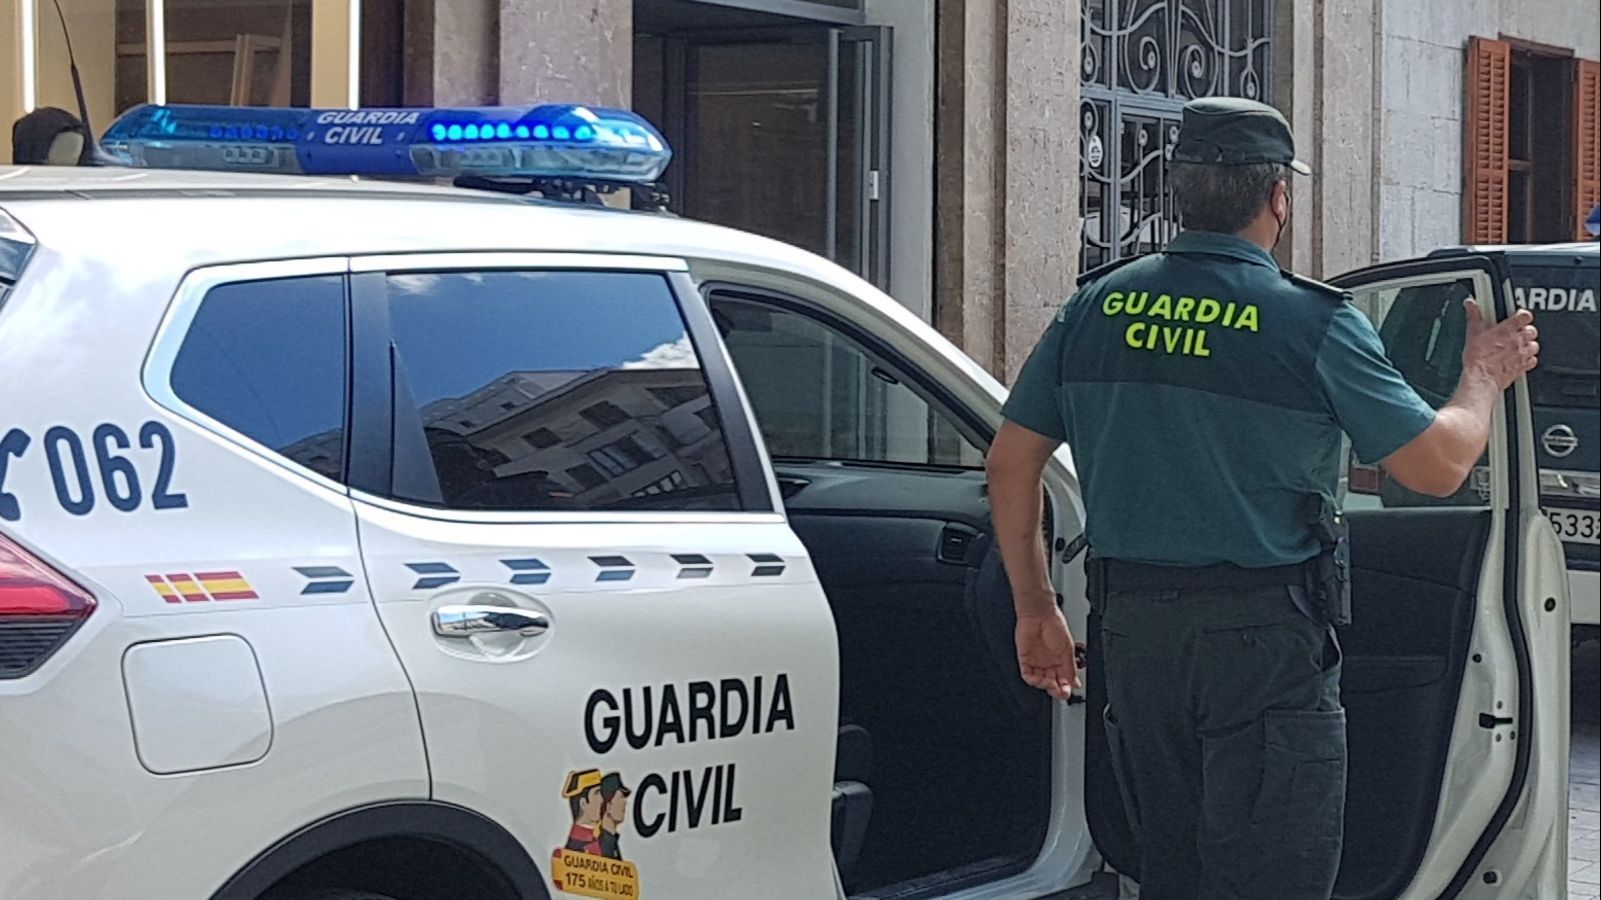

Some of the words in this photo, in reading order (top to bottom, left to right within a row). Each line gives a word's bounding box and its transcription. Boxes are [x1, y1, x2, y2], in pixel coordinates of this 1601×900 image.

[317, 111, 420, 125] GUARDIA
[324, 126, 383, 145] CIVIL
[1102, 291, 1259, 332] GUARDIA
[1125, 322, 1211, 357] CIVIL
[43, 420, 189, 516] 062
[584, 673, 795, 754] GUARDIA
[632, 763, 743, 839] CIVIL
[564, 855, 609, 874] GUARDIA
[610, 863, 634, 878] CIVIL
[566, 872, 586, 888] 175
